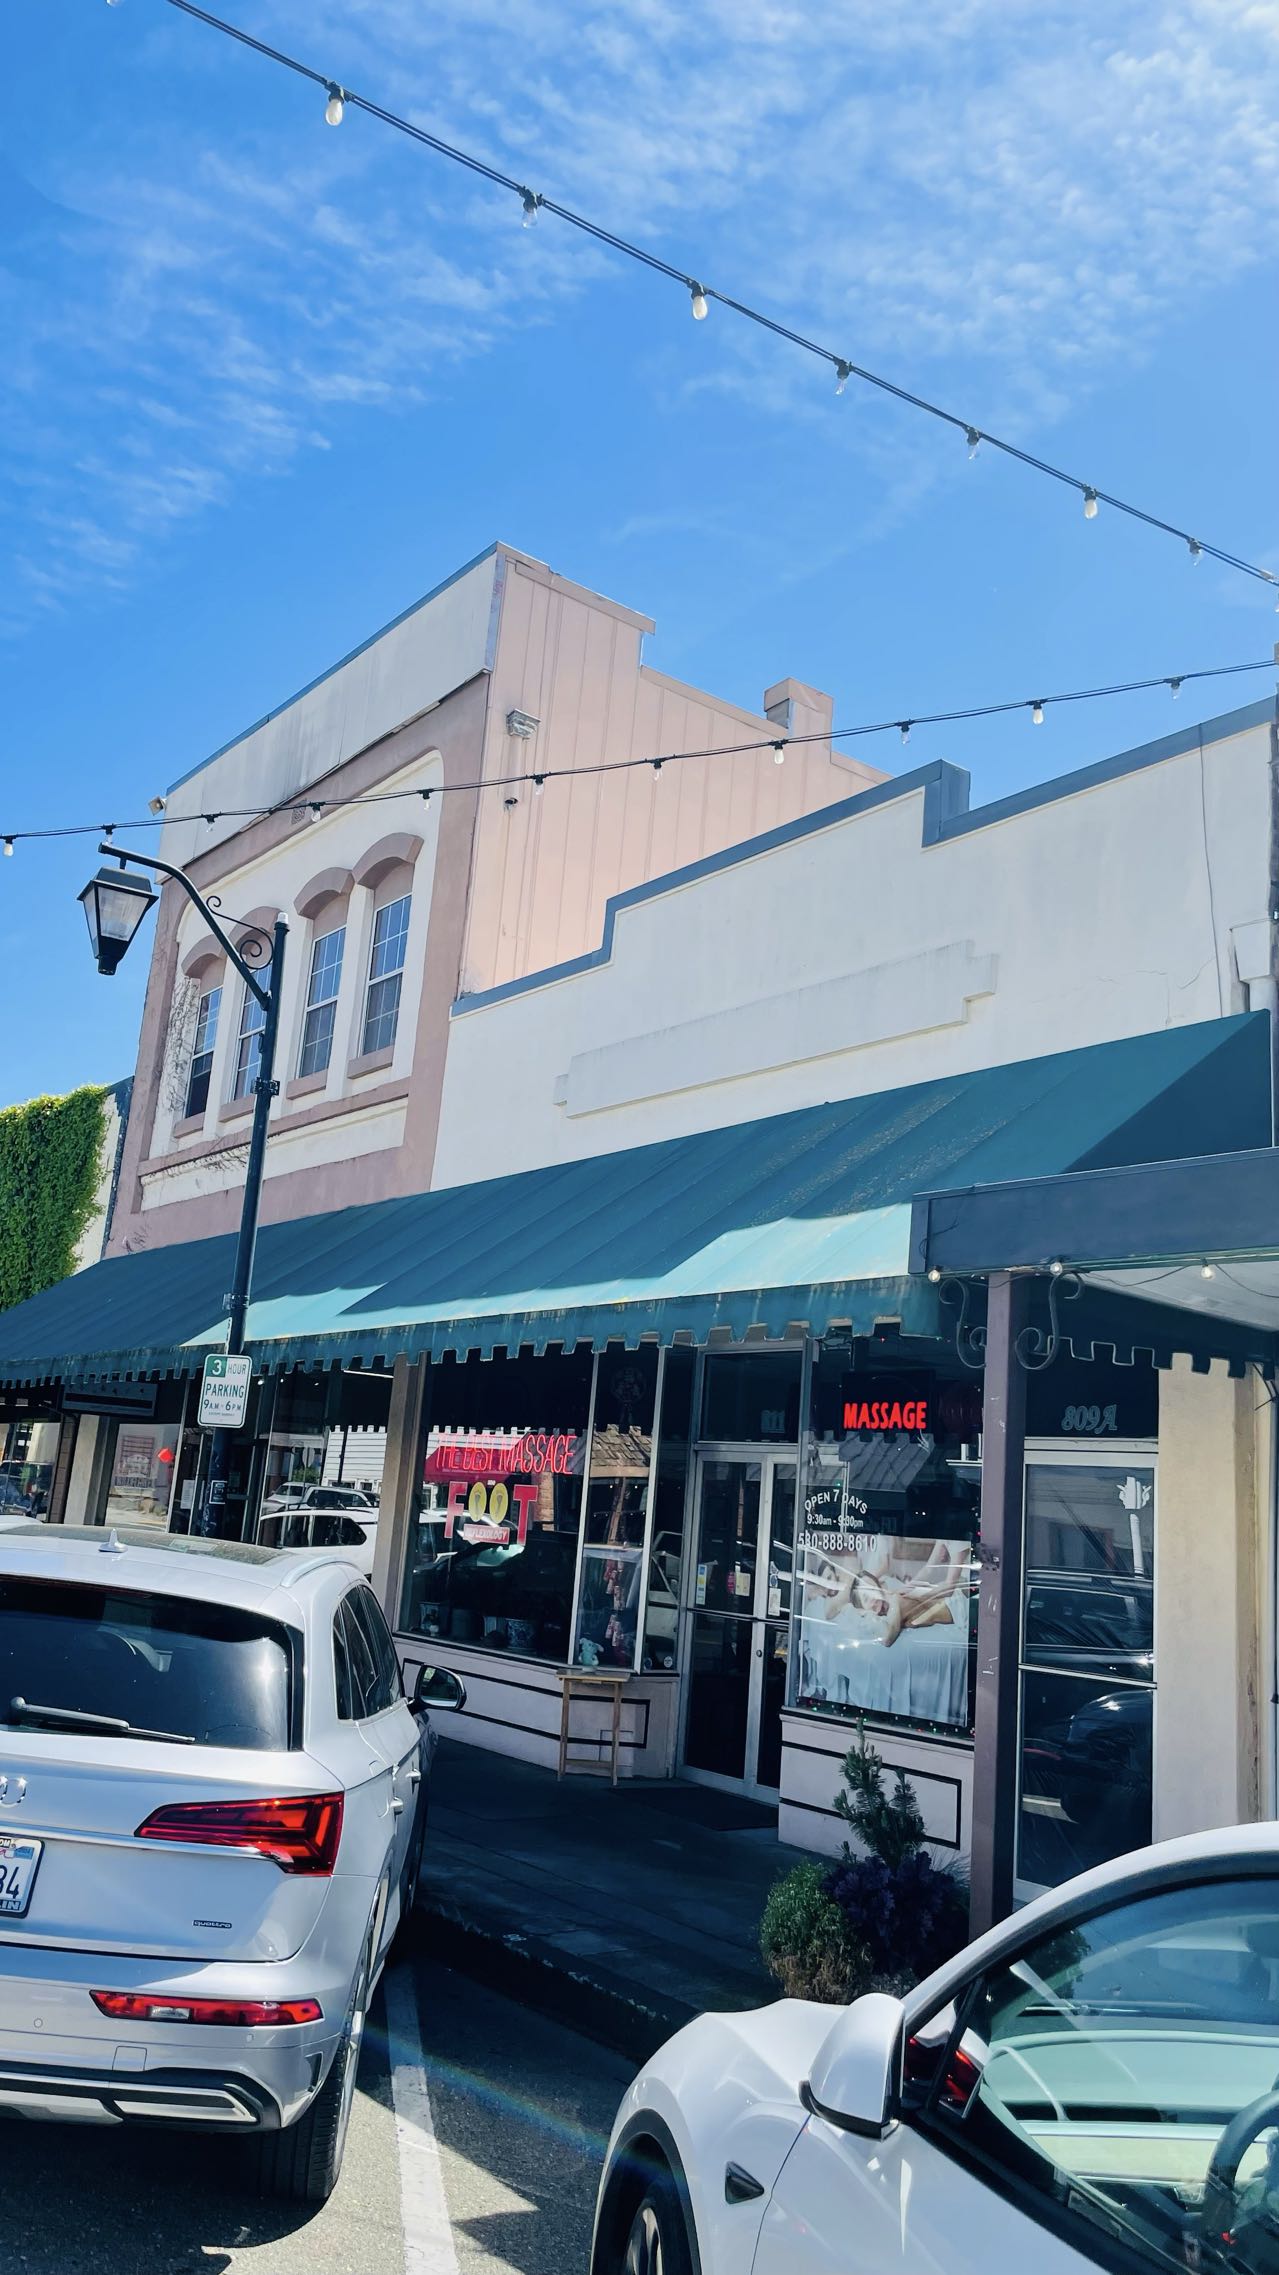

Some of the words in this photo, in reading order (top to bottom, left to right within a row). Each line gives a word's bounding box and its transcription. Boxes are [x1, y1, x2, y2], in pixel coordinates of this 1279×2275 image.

[212, 1359, 222, 1375] 3
[227, 1363, 247, 1375] HOUR
[205, 1383, 245, 1398] PARKING
[843, 1401, 927, 1430] MASSAGE
[1061, 1404, 1118, 1434] 809A
[436, 1433, 462, 1469] THE
[463, 1434, 496, 1471] BEST
[498, 1433, 577, 1474] MASSAGE
[444, 1481, 538, 1546] FOOT
[804, 1491, 831, 1513] OPEN
[833, 1489, 840, 1502] 7
[842, 1493, 868, 1515] DAYS
[807, 1513, 832, 1526] 9:30am
[838, 1514, 864, 1529] 9:30pm
[194, 1920, 231, 1928] quattro
